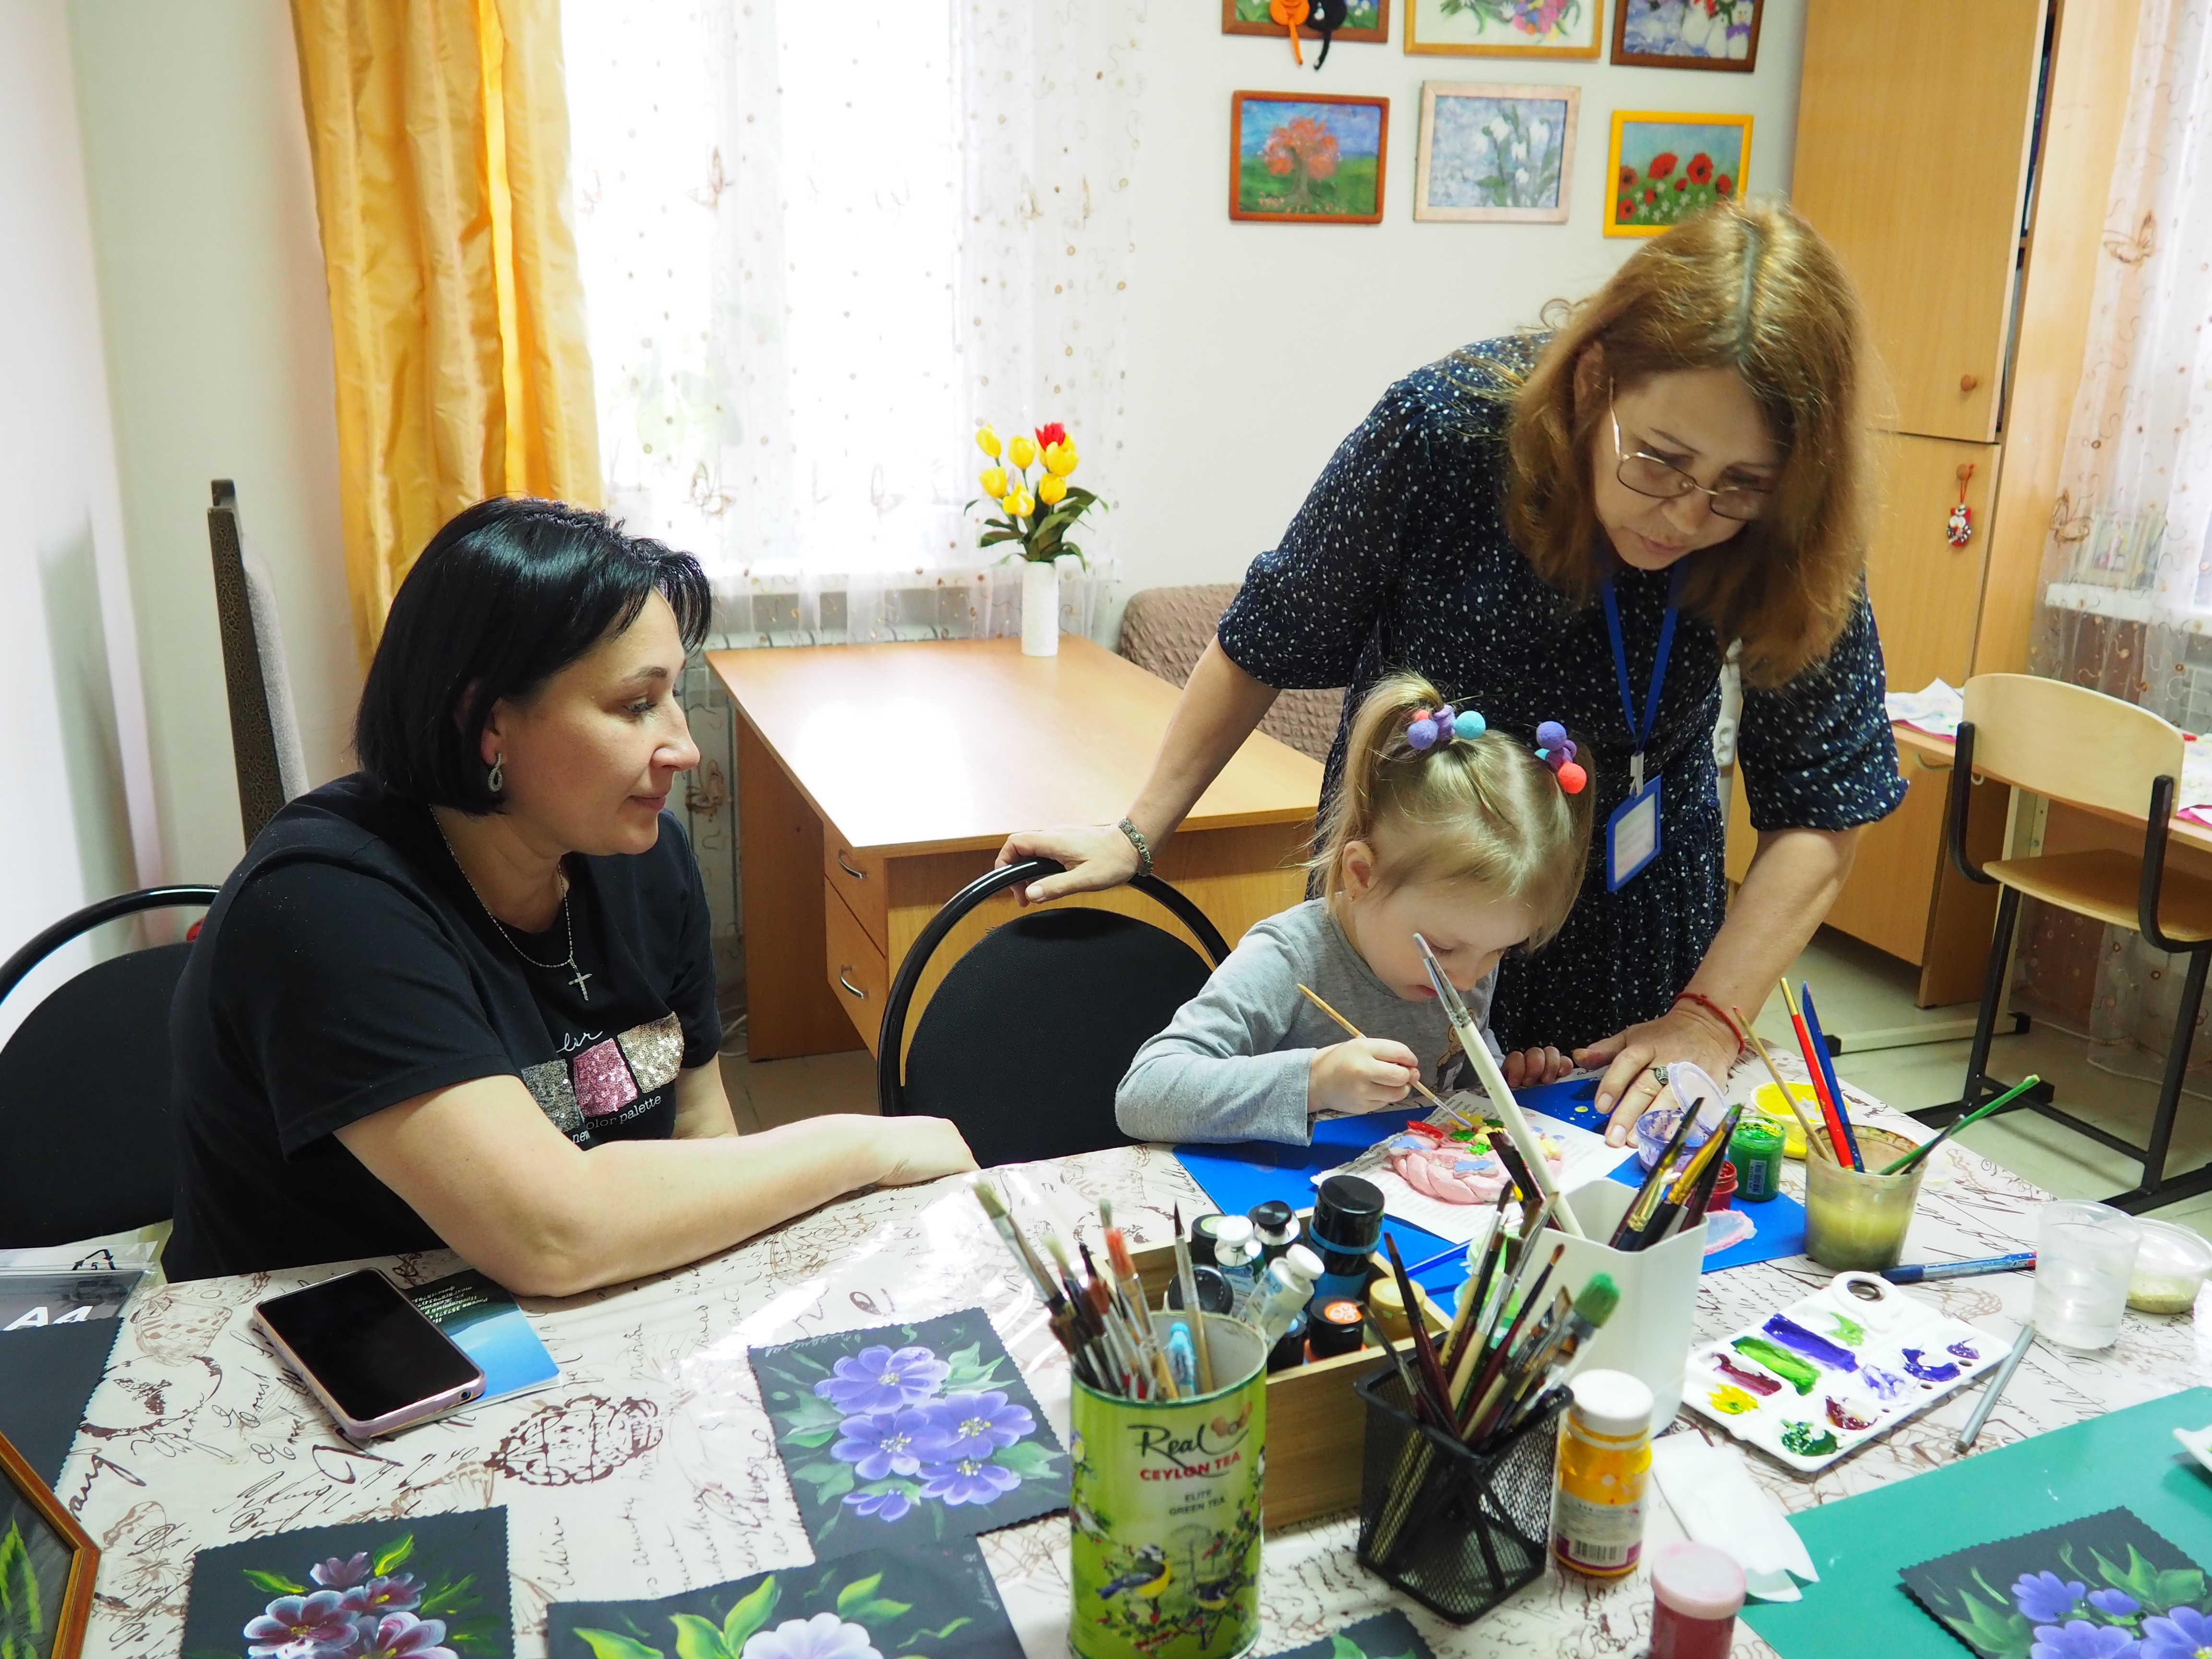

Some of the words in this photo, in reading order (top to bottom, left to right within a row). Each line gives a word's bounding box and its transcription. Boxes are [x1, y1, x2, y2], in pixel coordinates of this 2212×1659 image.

[585, 1117, 617, 1130] olor
[619, 1095, 661, 1124] palette
[462, 1297, 488, 1308] Россия
[2, 1306, 94, 1332] A4
[1127, 1423, 1249, 1478] Real
[1140, 1462, 1210, 1481] CEYLON
[1214, 1450, 1241, 1470] TEA
[1169, 1503, 1205, 1516] GREEN
[1208, 1495, 1226, 1508] TEA
[1185, 1489, 1212, 1502] ELITE
